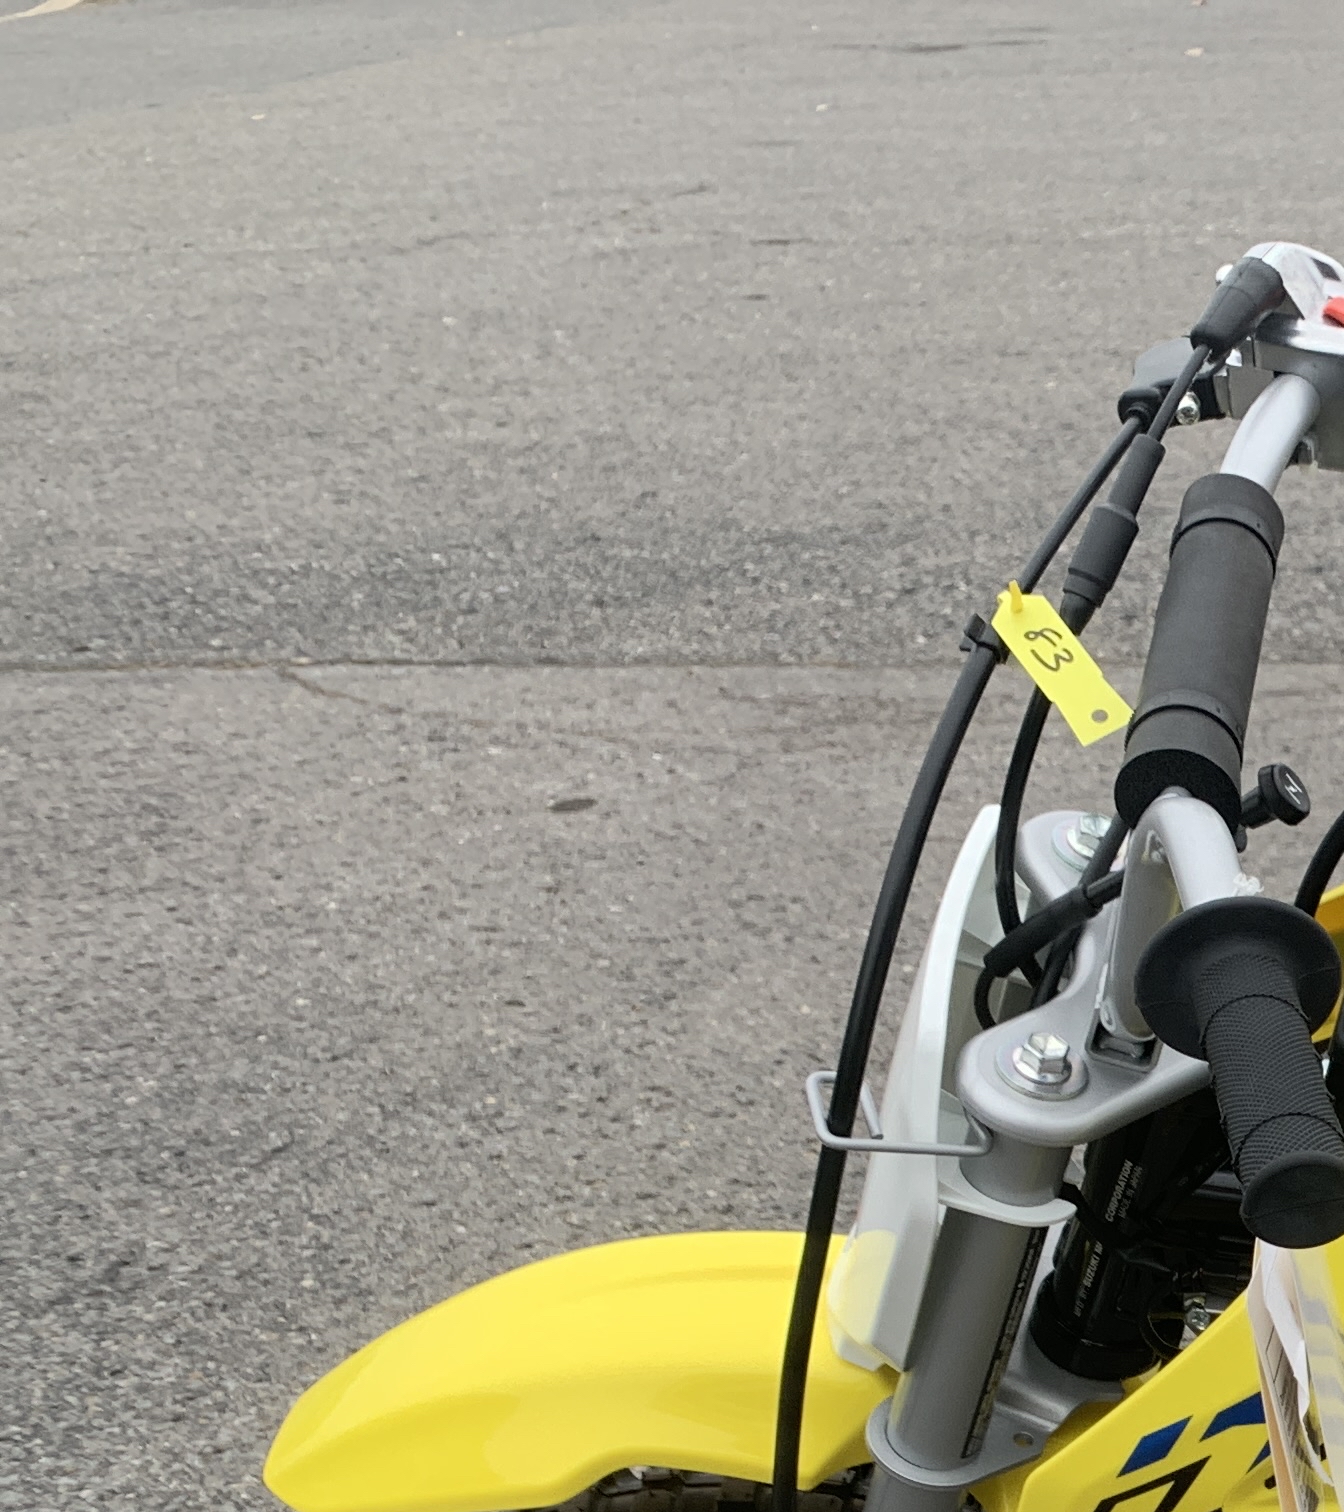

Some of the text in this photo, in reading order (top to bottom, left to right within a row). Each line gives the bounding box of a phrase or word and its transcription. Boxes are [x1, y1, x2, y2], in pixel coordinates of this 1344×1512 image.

[1104, 1158, 1134, 1222] CORPORATION
[1117, 1198, 1131, 1219] MADE
[1082, 1254, 1101, 1288] SUZUKI
